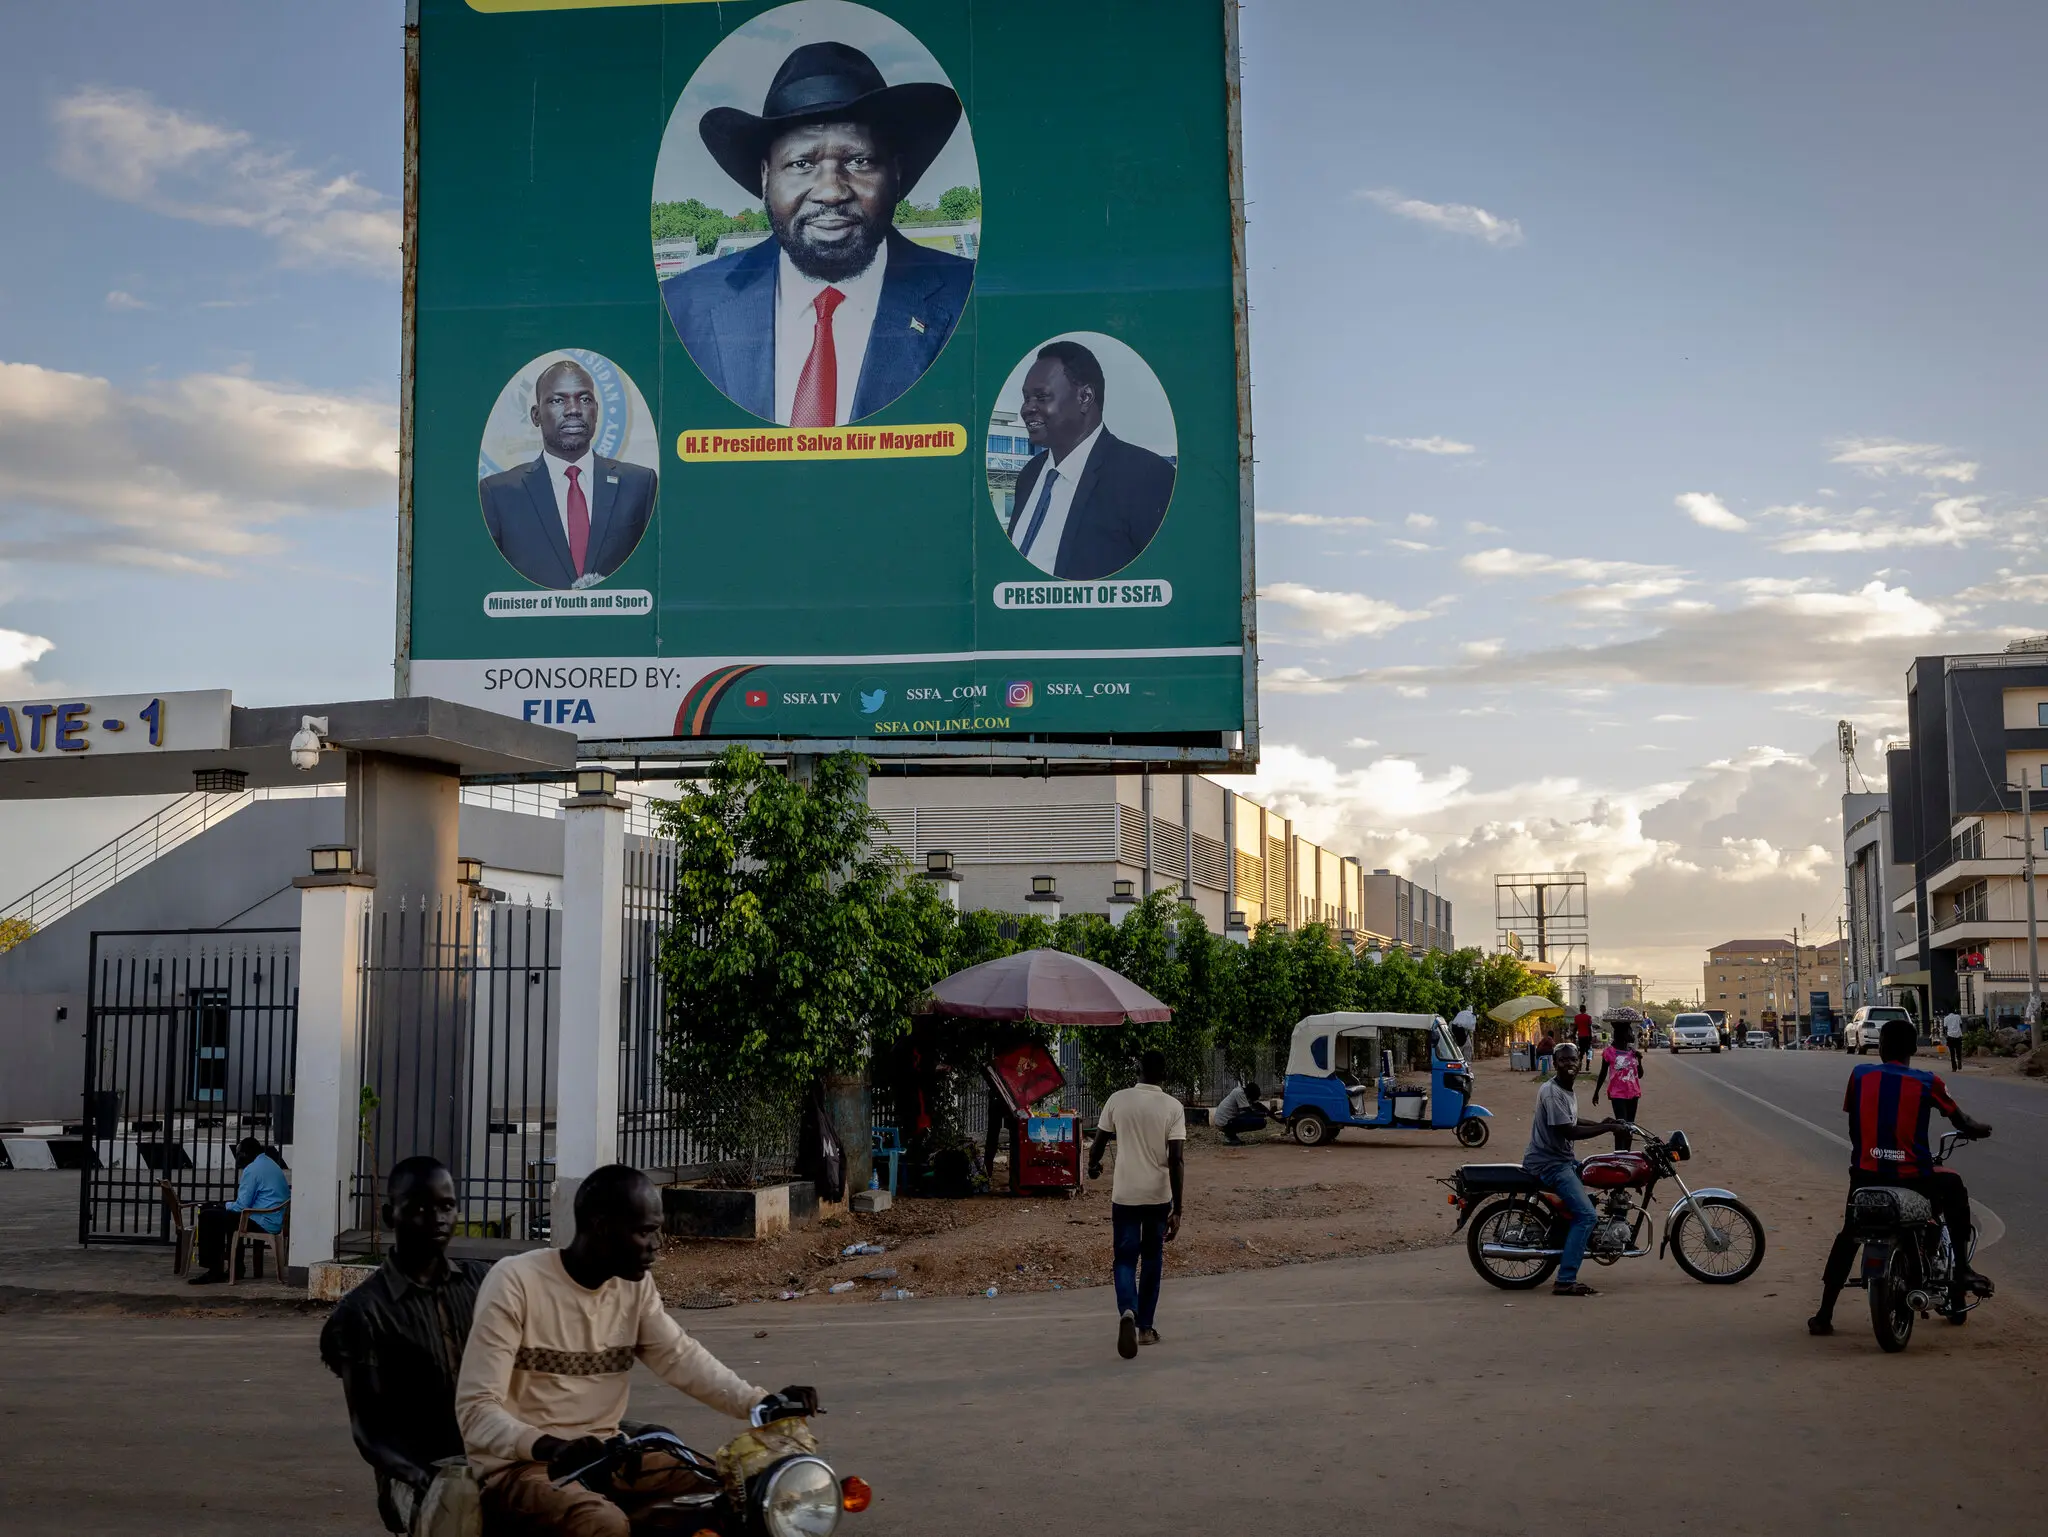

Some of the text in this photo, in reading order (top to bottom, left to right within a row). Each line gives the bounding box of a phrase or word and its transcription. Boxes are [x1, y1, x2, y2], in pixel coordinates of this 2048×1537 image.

[685, 430, 955, 453] H.E President Salva Kiir Mayardit
[488, 594, 648, 610] Minister of Youth and Sport
[1004, 585, 1163, 605] PRESIDENT OF SSFA
[484, 667, 681, 690] SPONSORED BY:
[783, 692, 841, 705] SSFA TV
[523, 698, 597, 724] FIFA
[139, 698, 166, 747] 1
[874, 717, 1010, 734] SSFA ONLINE.COM
